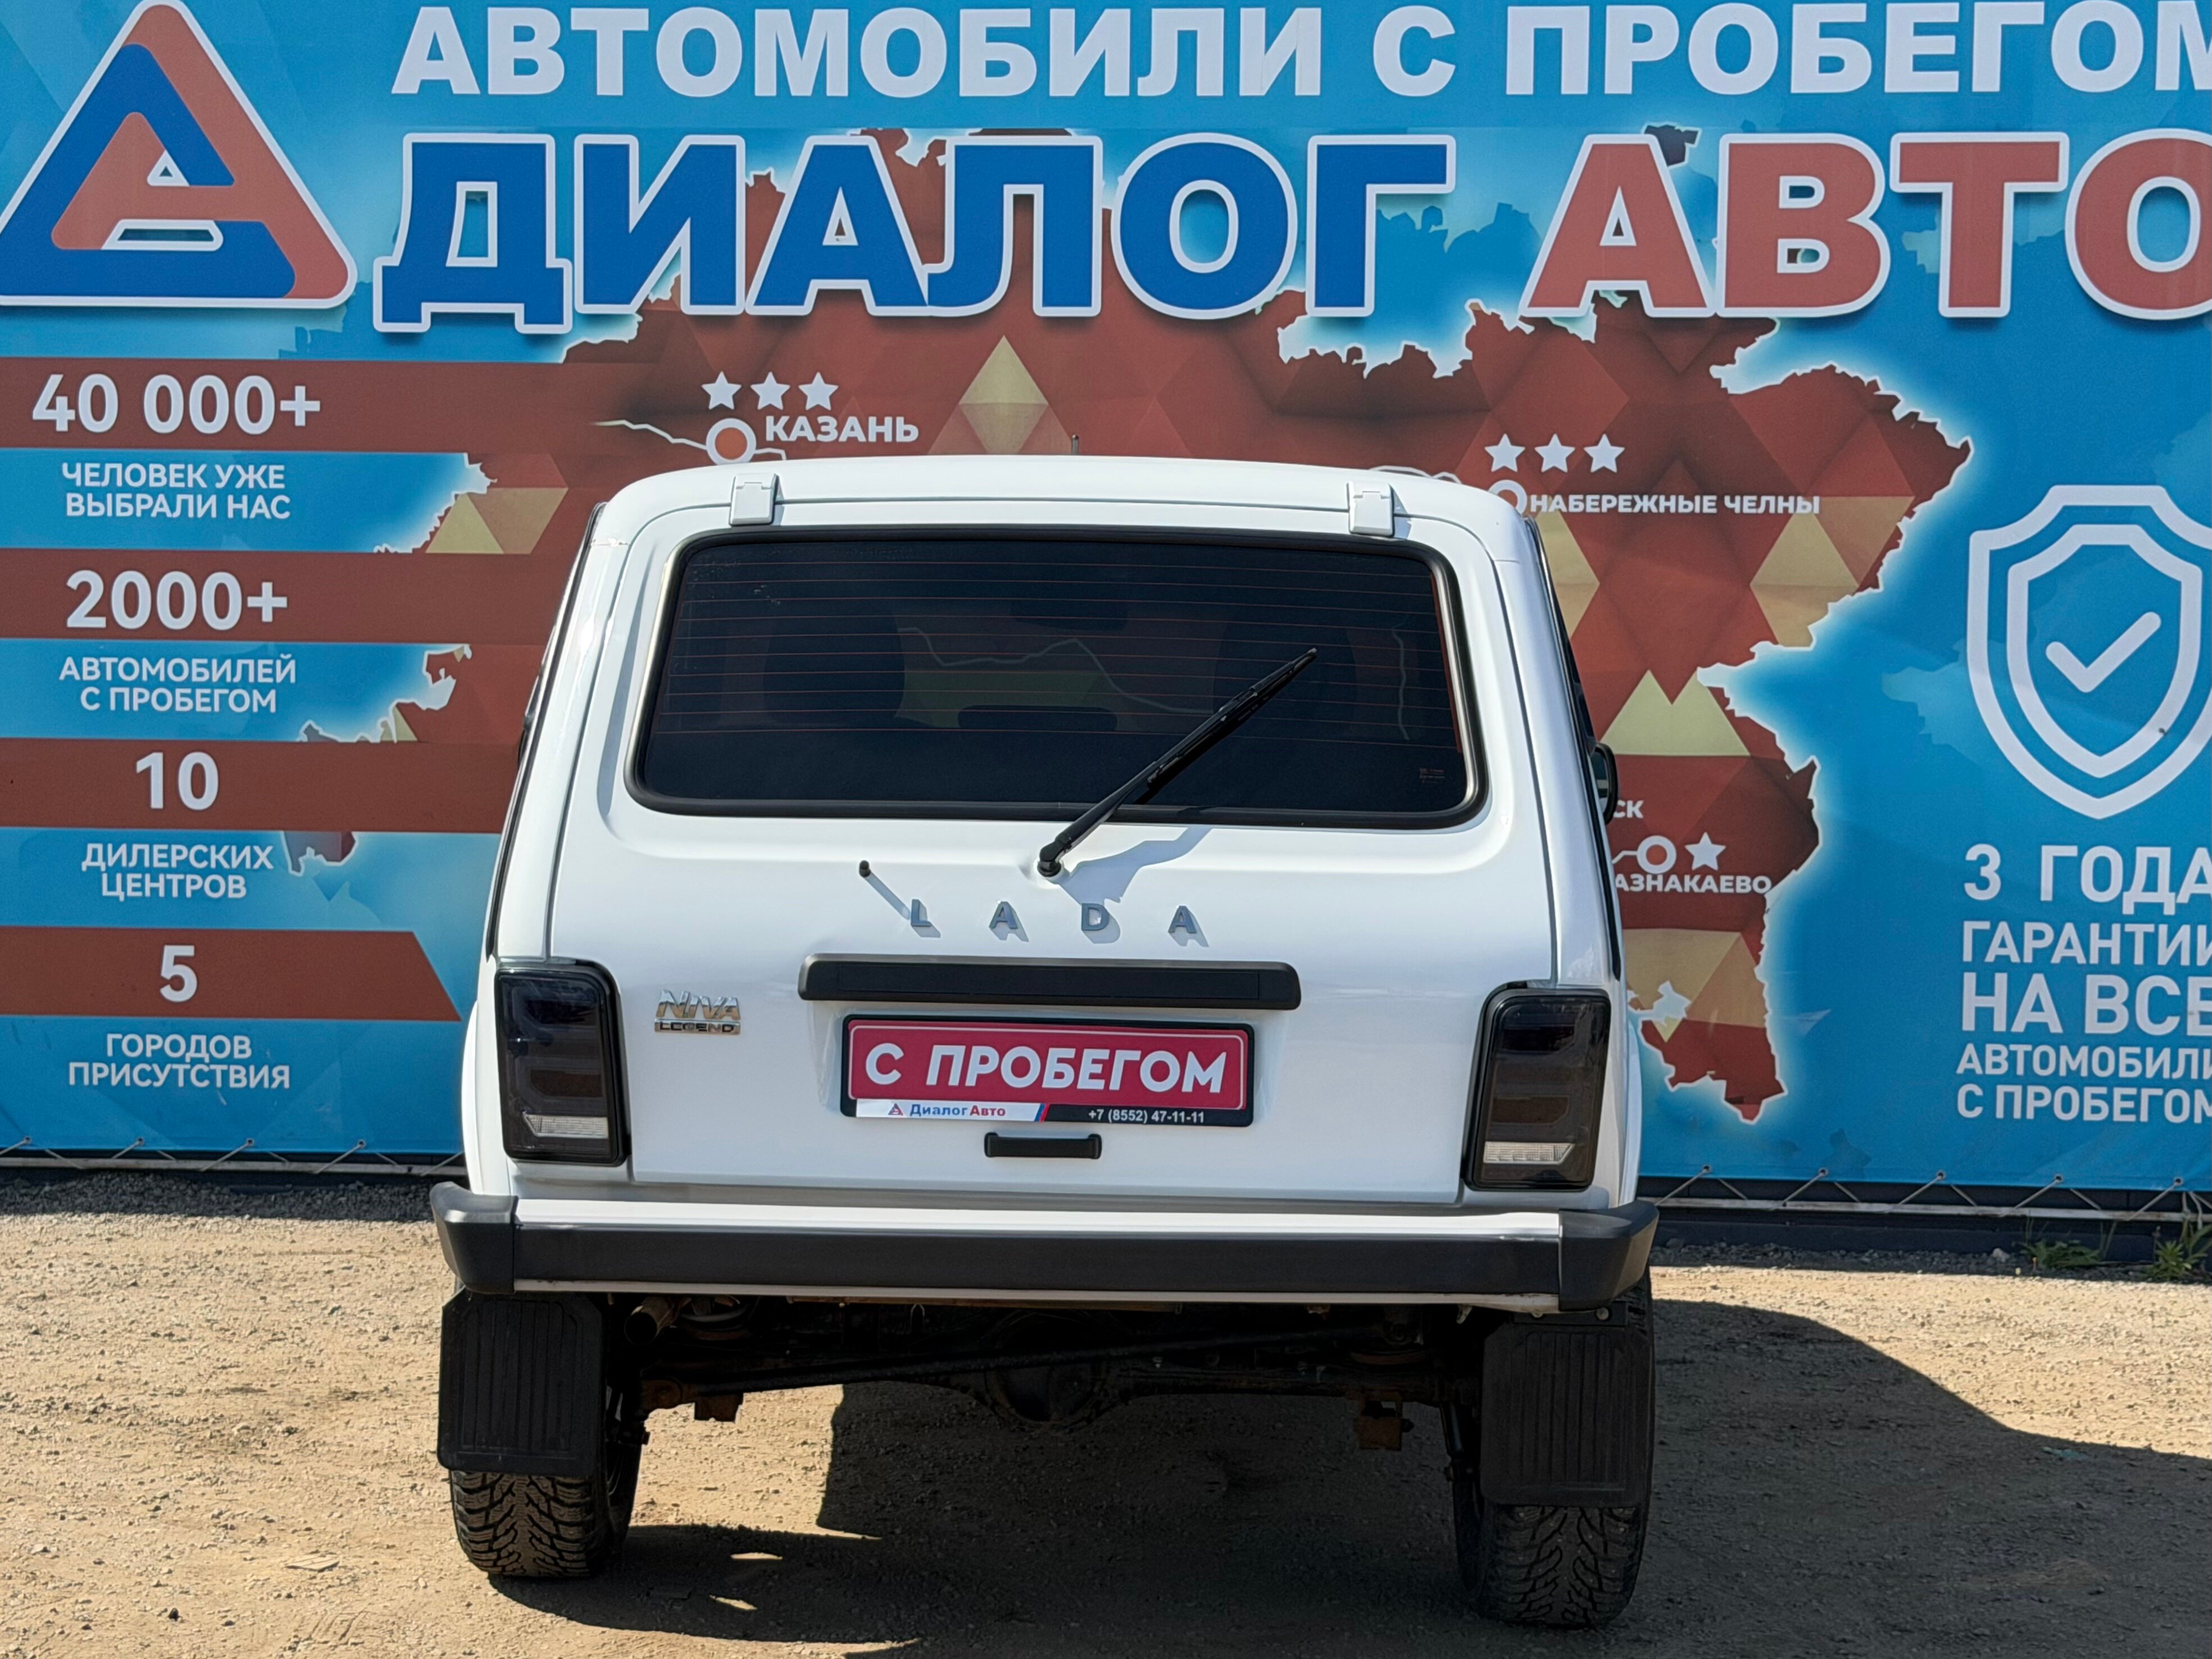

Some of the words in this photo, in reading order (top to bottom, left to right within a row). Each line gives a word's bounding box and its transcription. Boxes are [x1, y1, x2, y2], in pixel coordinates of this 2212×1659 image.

[392, 6, 1321, 97] АВТОМОБИЛИ
[1373, 5, 1456, 97] С
[1506, 0, 2212, 96] ПРОБЕГОМ
[373, 133, 1456, 334] ДИАЛОГ
[1518, 129, 2212, 320] АВТО
[33, 374, 119, 433] 40
[143, 374, 320, 434] 000+
[766, 416, 919, 442] КАЗАНЬ
[62, 462, 207, 488] ЧЕЛОВЕК
[214, 464, 285, 489] УЖЕ
[66, 493, 217, 518] ВЫБРАЛИ
[227, 495, 291, 519] НАС
[1530, 495, 1717, 514] НАБЕРЕЖНЫЕ
[1724, 496, 1820, 514] ЧЕЛНЫ
[66, 570, 288, 631] 2000+
[59, 653, 296, 683] АВТОМОБИЛЕЙ
[80, 687, 99, 711] С
[110, 688, 276, 713] ПРОБЕГОМ
[136, 752, 219, 810] 10
[81, 843, 274, 872] ДИЛЕРСКИХ
[102, 873, 247, 901] ЦЕНТРОВ
[1615, 873, 1772, 894] АЗНАКАЕВО
[1964, 844, 2001, 900] 3
[2041, 845, 2212, 915] ГОДА
[911, 899, 1197, 934] LADA
[160, 945, 198, 1003] 5
[656, 989, 741, 1020] NIVA
[1963, 972, 2063, 1034] НА
[2084, 974, 2212, 1036] ВСЕ
[107, 1034, 251, 1062] ГОРОДОВ
[69, 1062, 290, 1089] ПРИСУТСТВИЯ
[866, 1042, 903, 1085] С
[926, 1045, 1227, 1094] ПРОБЕГОМ
[1088, 1108, 1104, 1121] +7
[1108, 1109, 1147, 1123] (8552)
[1151, 1110, 1204, 1123] 47-11-11
[1957, 1084, 1983, 1118] С
[1996, 1085, 2212, 1123] ПРОБЕГОМ
